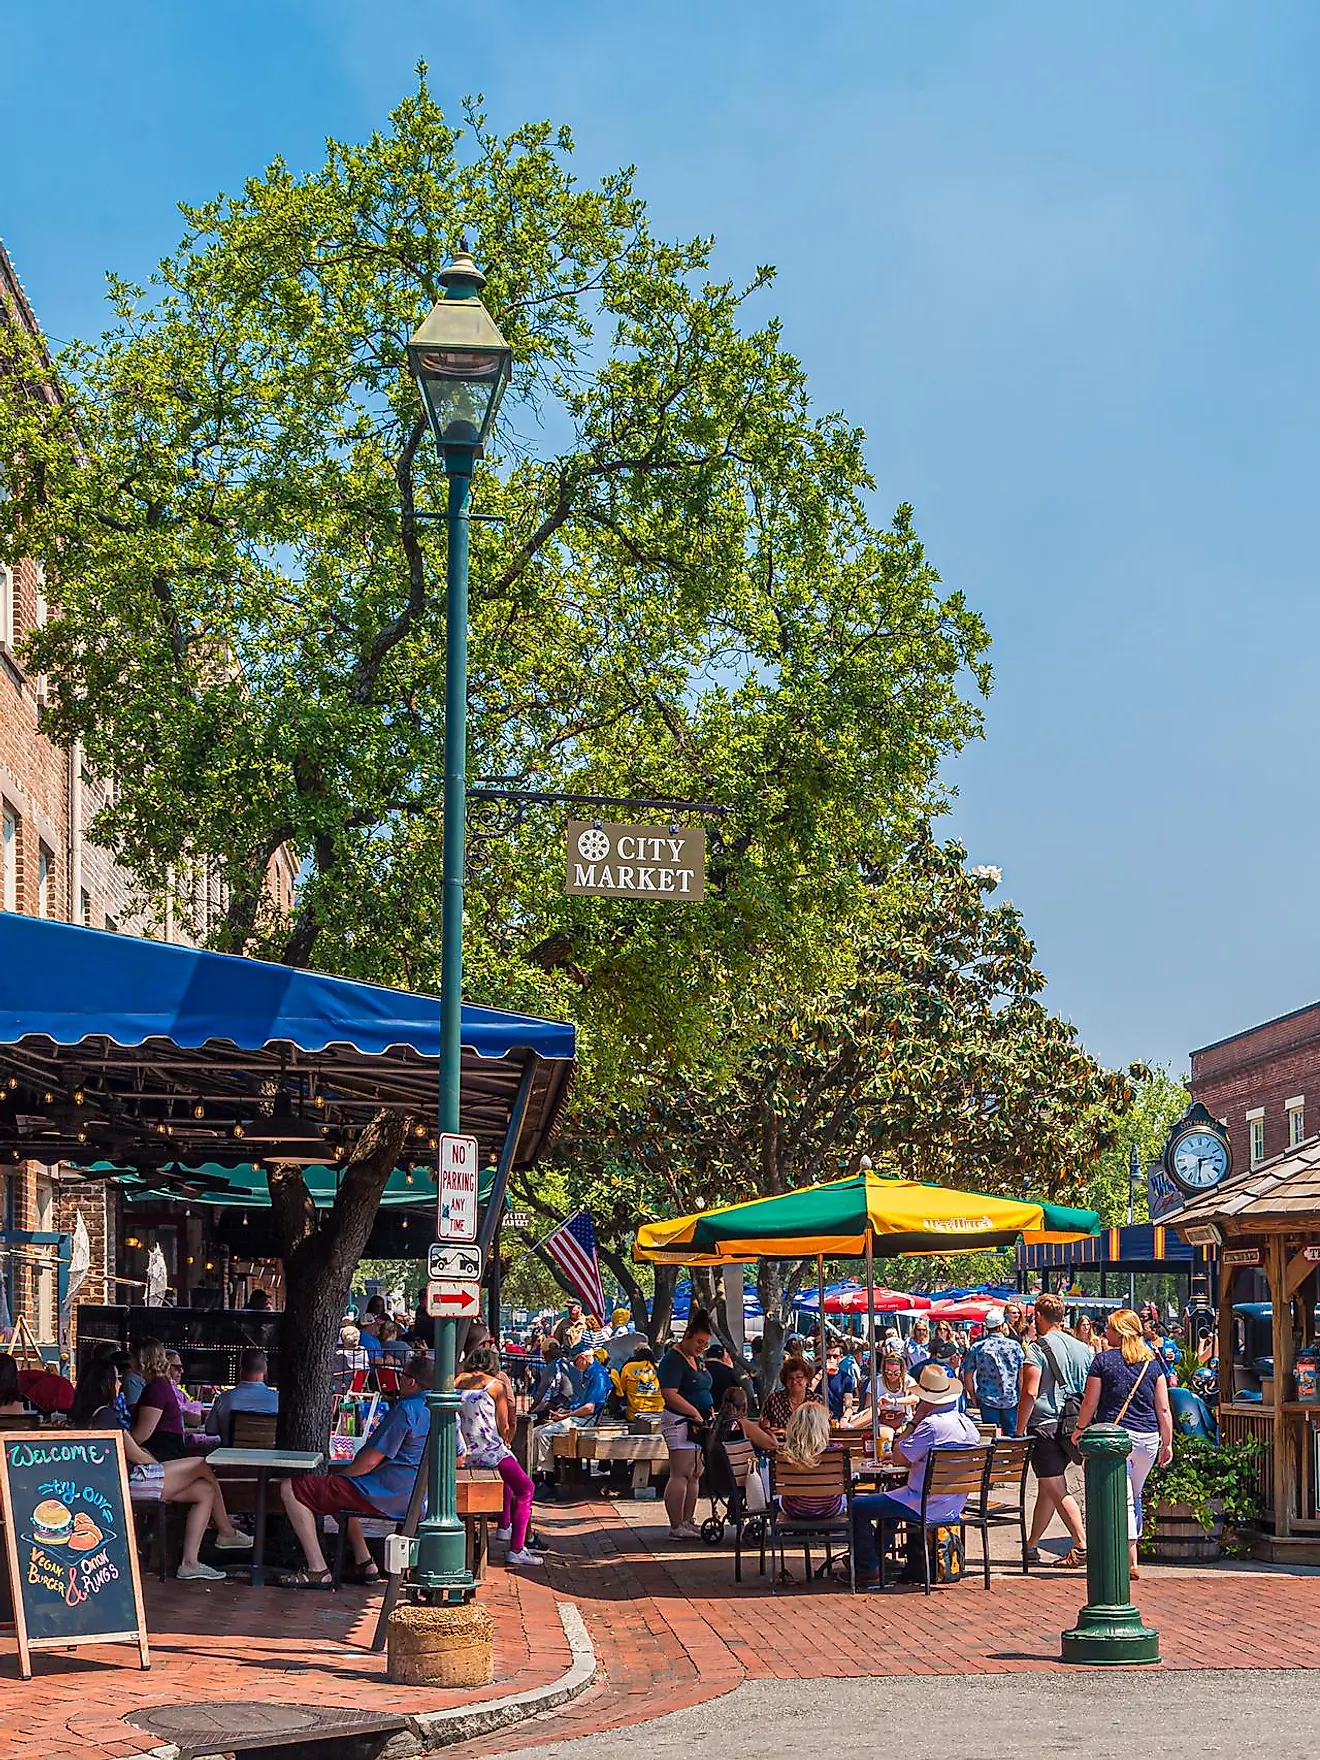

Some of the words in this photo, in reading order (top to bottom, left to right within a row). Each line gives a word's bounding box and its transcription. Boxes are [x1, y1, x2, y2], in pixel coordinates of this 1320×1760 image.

[617, 836, 686, 862] CITY
[573, 864, 695, 893] MARKET
[452, 1145, 466, 1164] NO
[442, 1171, 475, 1192] PARKING
[451, 1198, 466, 1211] ANY
[449, 1219, 466, 1232] TIME
[7, 1445, 104, 1467] WELCOME
[52, 1479, 80, 1504] try
[31, 1547, 63, 1577] VEGAN
[28, 1562, 66, 1597] BURGER
[66, 1567, 87, 1606] &
[81, 1564, 119, 1593] RINGS
